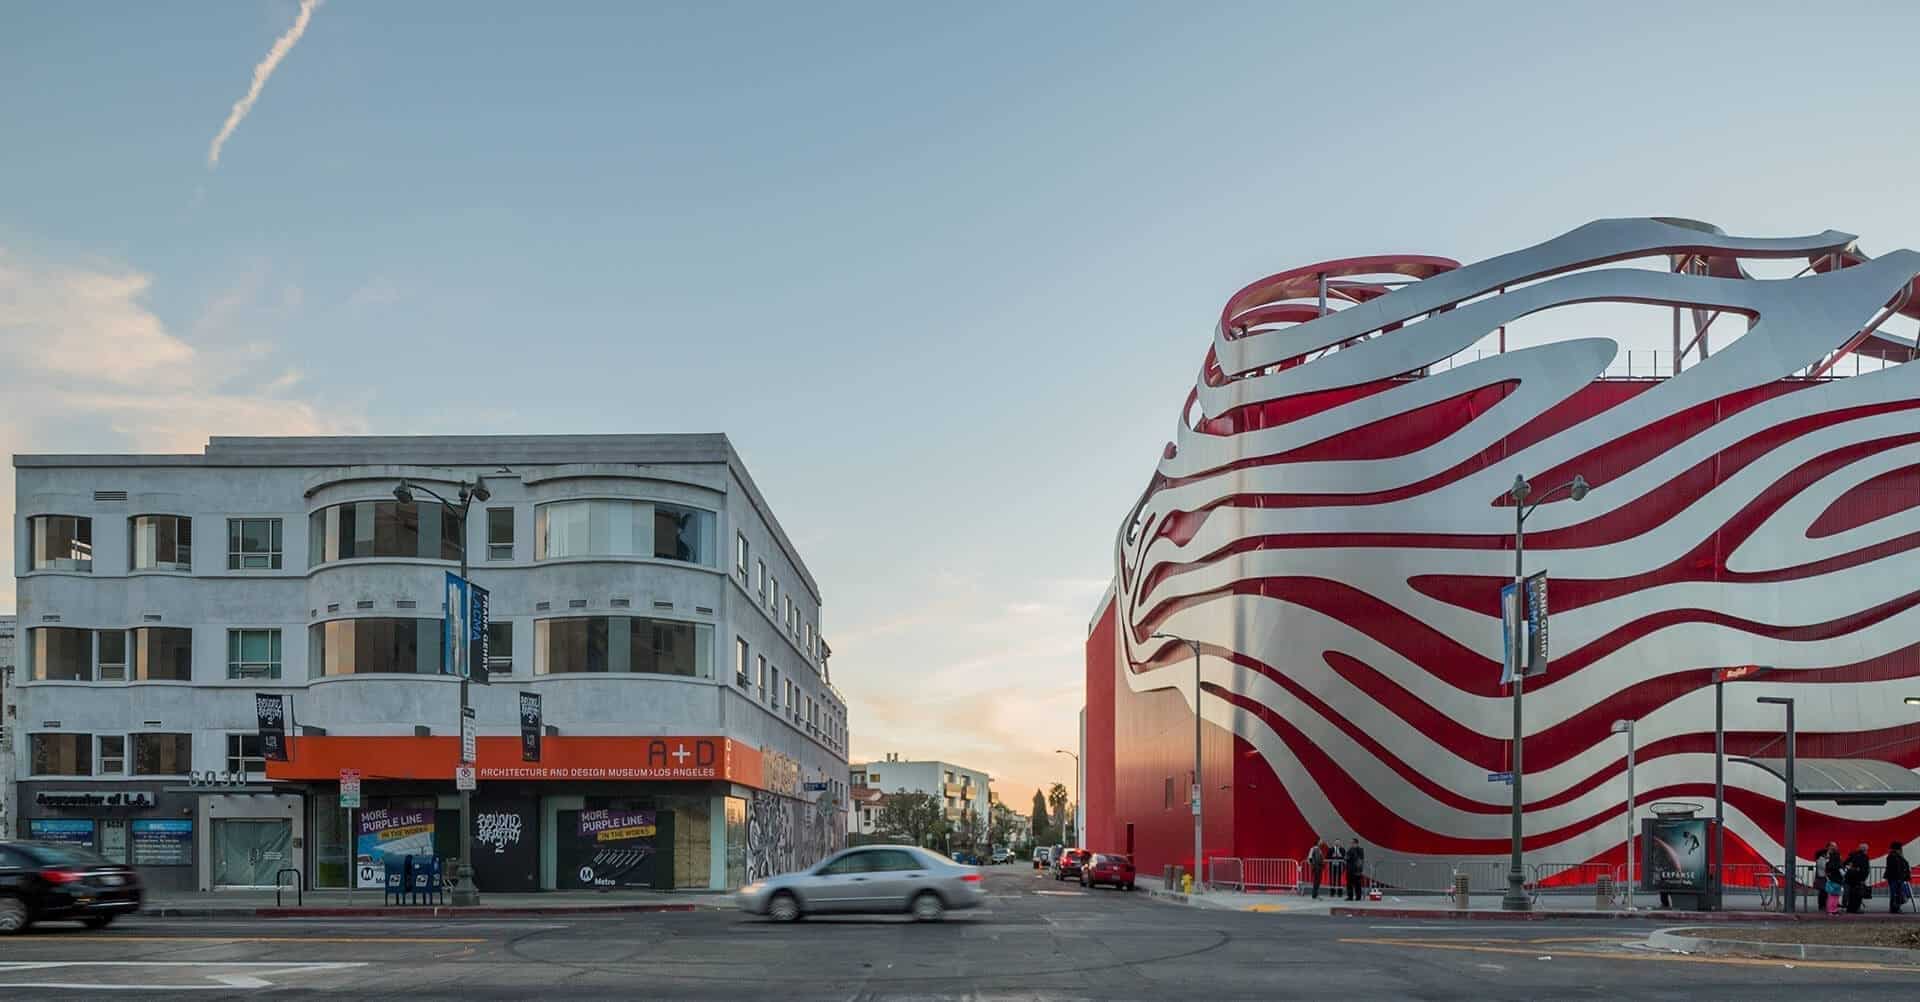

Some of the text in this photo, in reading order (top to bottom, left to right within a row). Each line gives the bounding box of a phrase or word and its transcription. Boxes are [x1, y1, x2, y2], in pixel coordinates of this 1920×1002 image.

[472, 591, 481, 641] LACMA
[649, 740, 716, 767] A+D
[480, 768, 548, 777] ARCHITECTURE
[550, 768, 568, 777] AND
[571, 768, 606, 777] DESIGN
[673, 768, 715, 777] ANGELES
[361, 809, 388, 822] MORE
[362, 813, 423, 833] PURPLE LINE
[581, 809, 609, 822] MORE
[582, 815, 644, 833] PURPLE LINE
[594, 877, 616, 887] Metro
